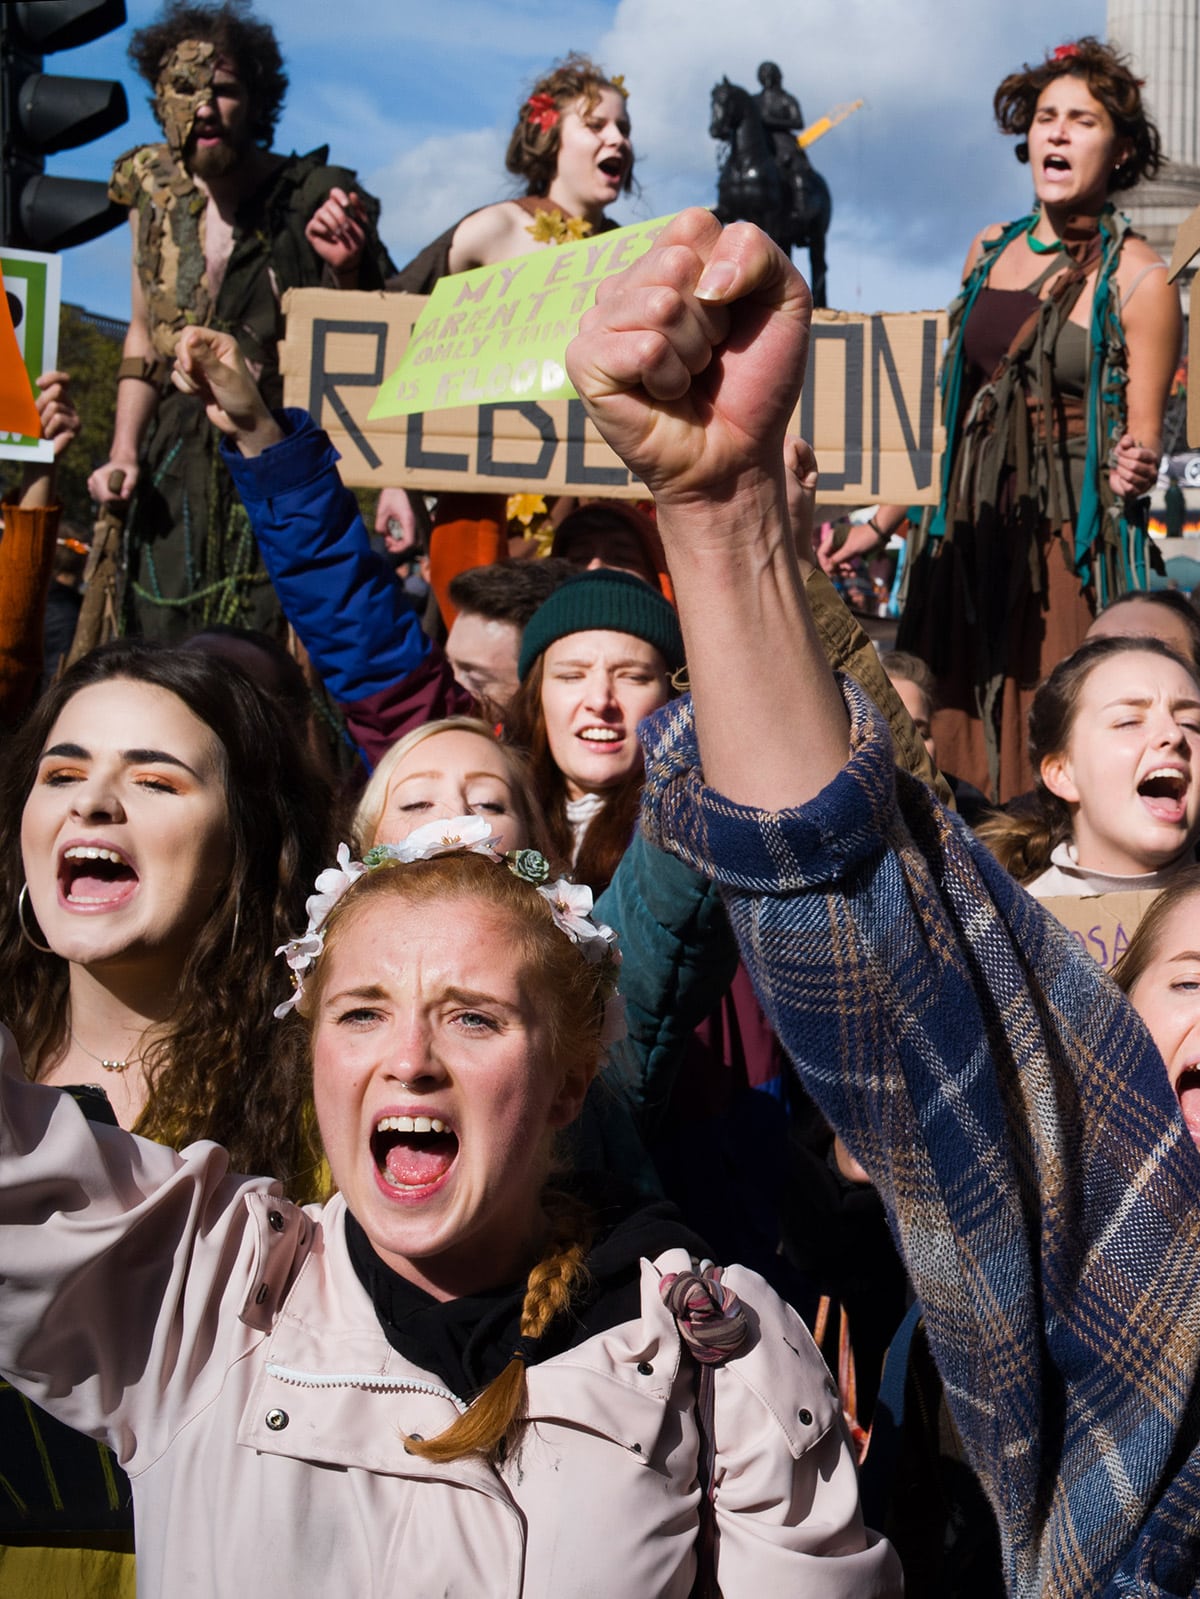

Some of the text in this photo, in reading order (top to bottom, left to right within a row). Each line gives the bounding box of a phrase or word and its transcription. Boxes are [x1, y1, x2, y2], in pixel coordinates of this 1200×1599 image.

[453, 262, 528, 308] MY
[413, 317, 579, 367] ONLY THIN
[396, 380, 420, 401] IS
